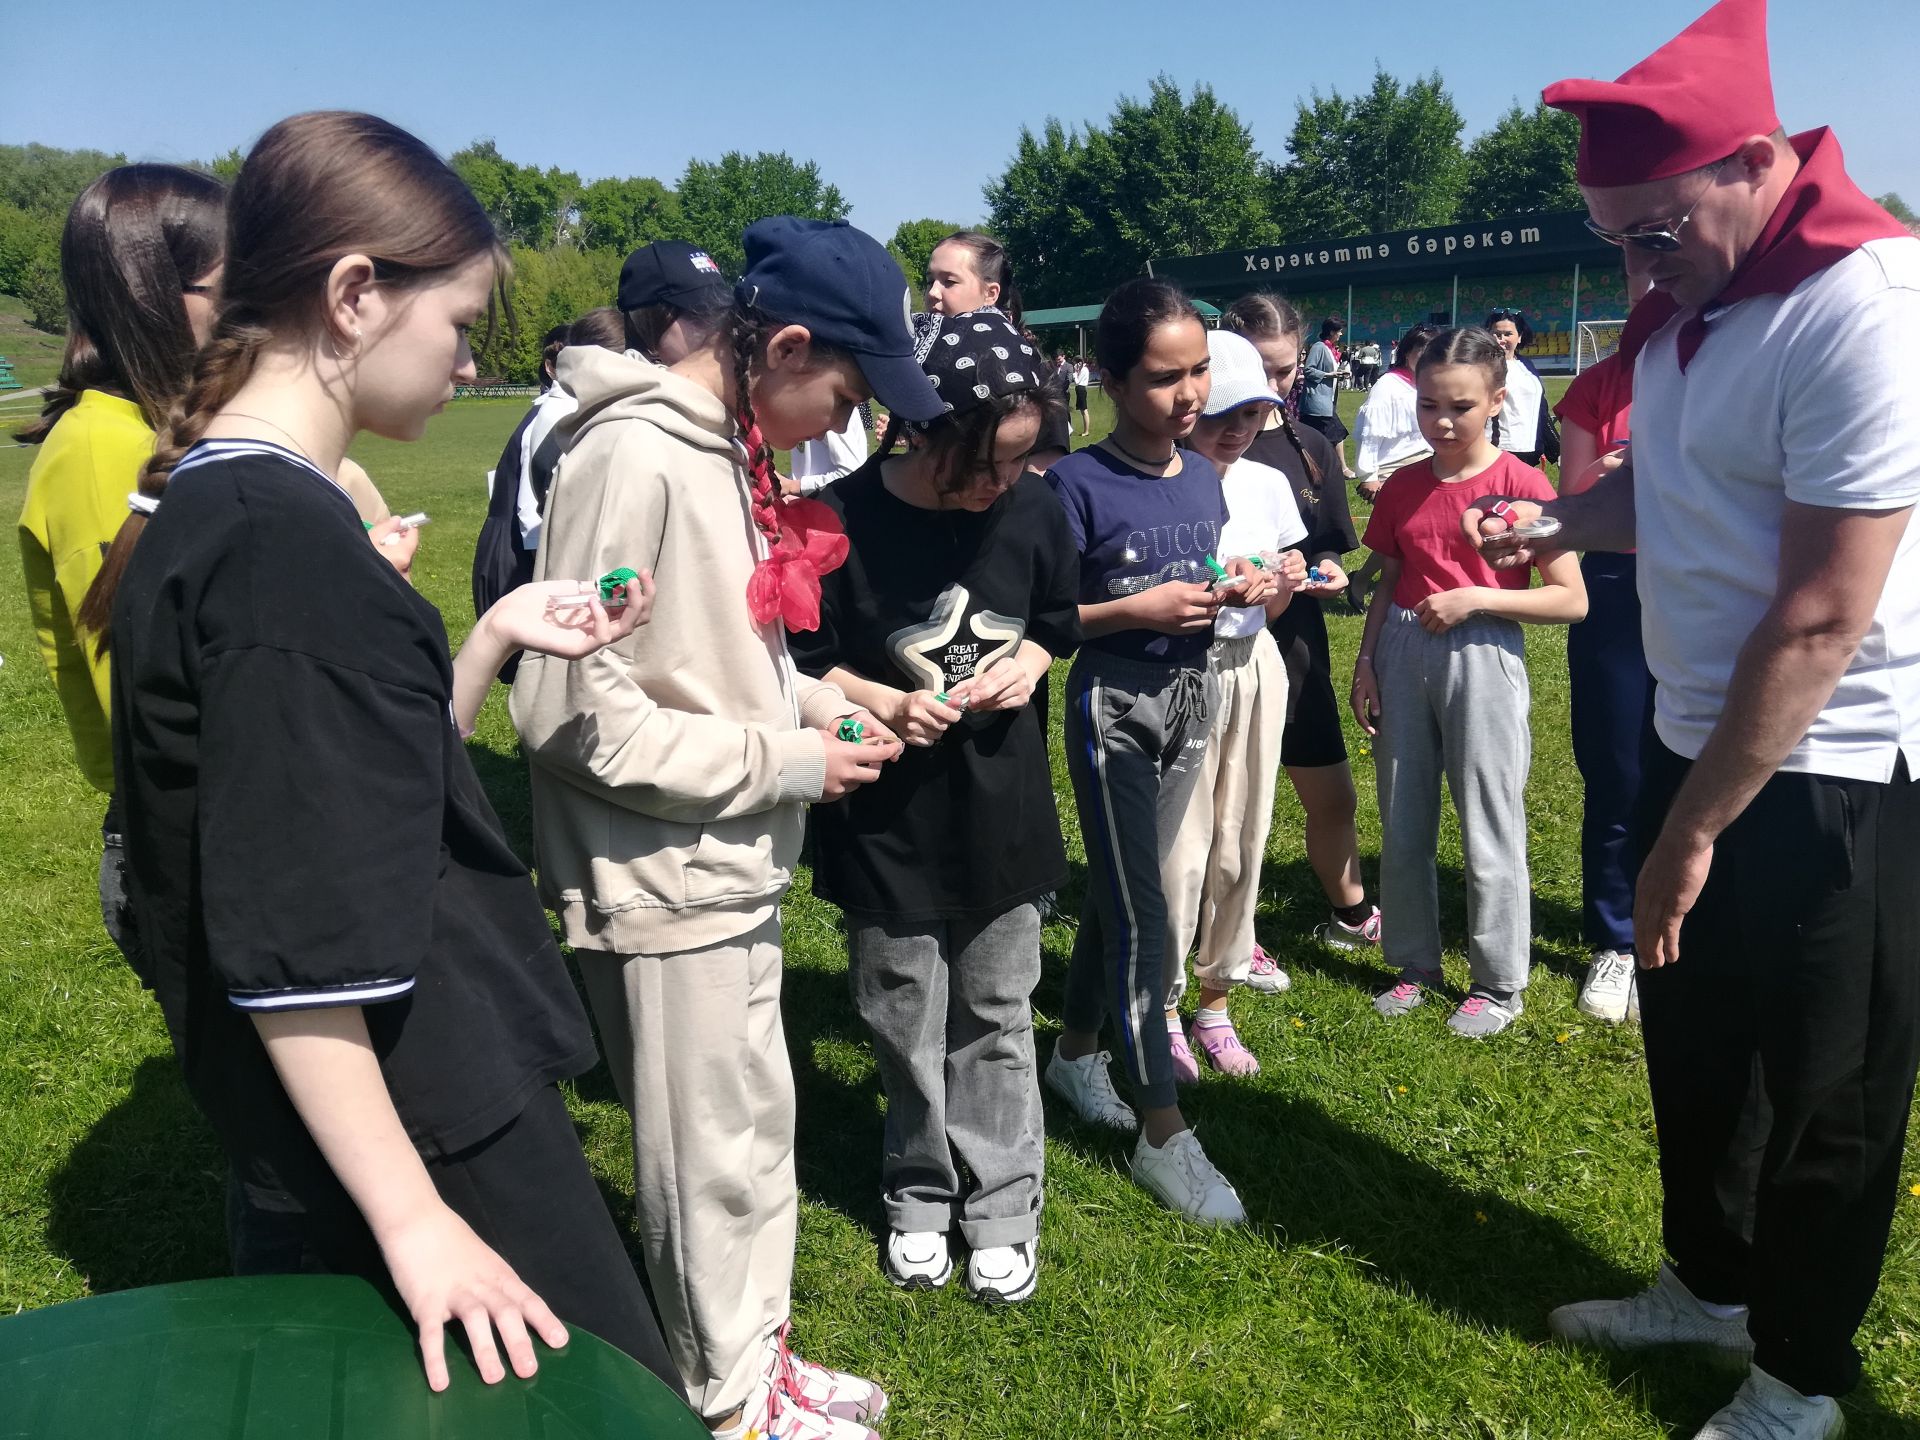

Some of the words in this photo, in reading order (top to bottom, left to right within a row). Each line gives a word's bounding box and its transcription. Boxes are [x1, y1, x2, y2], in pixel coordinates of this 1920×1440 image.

[1125, 520, 1217, 563] GUCCI
[948, 643, 978, 654] TREAT
[951, 663, 971, 674] WITH
